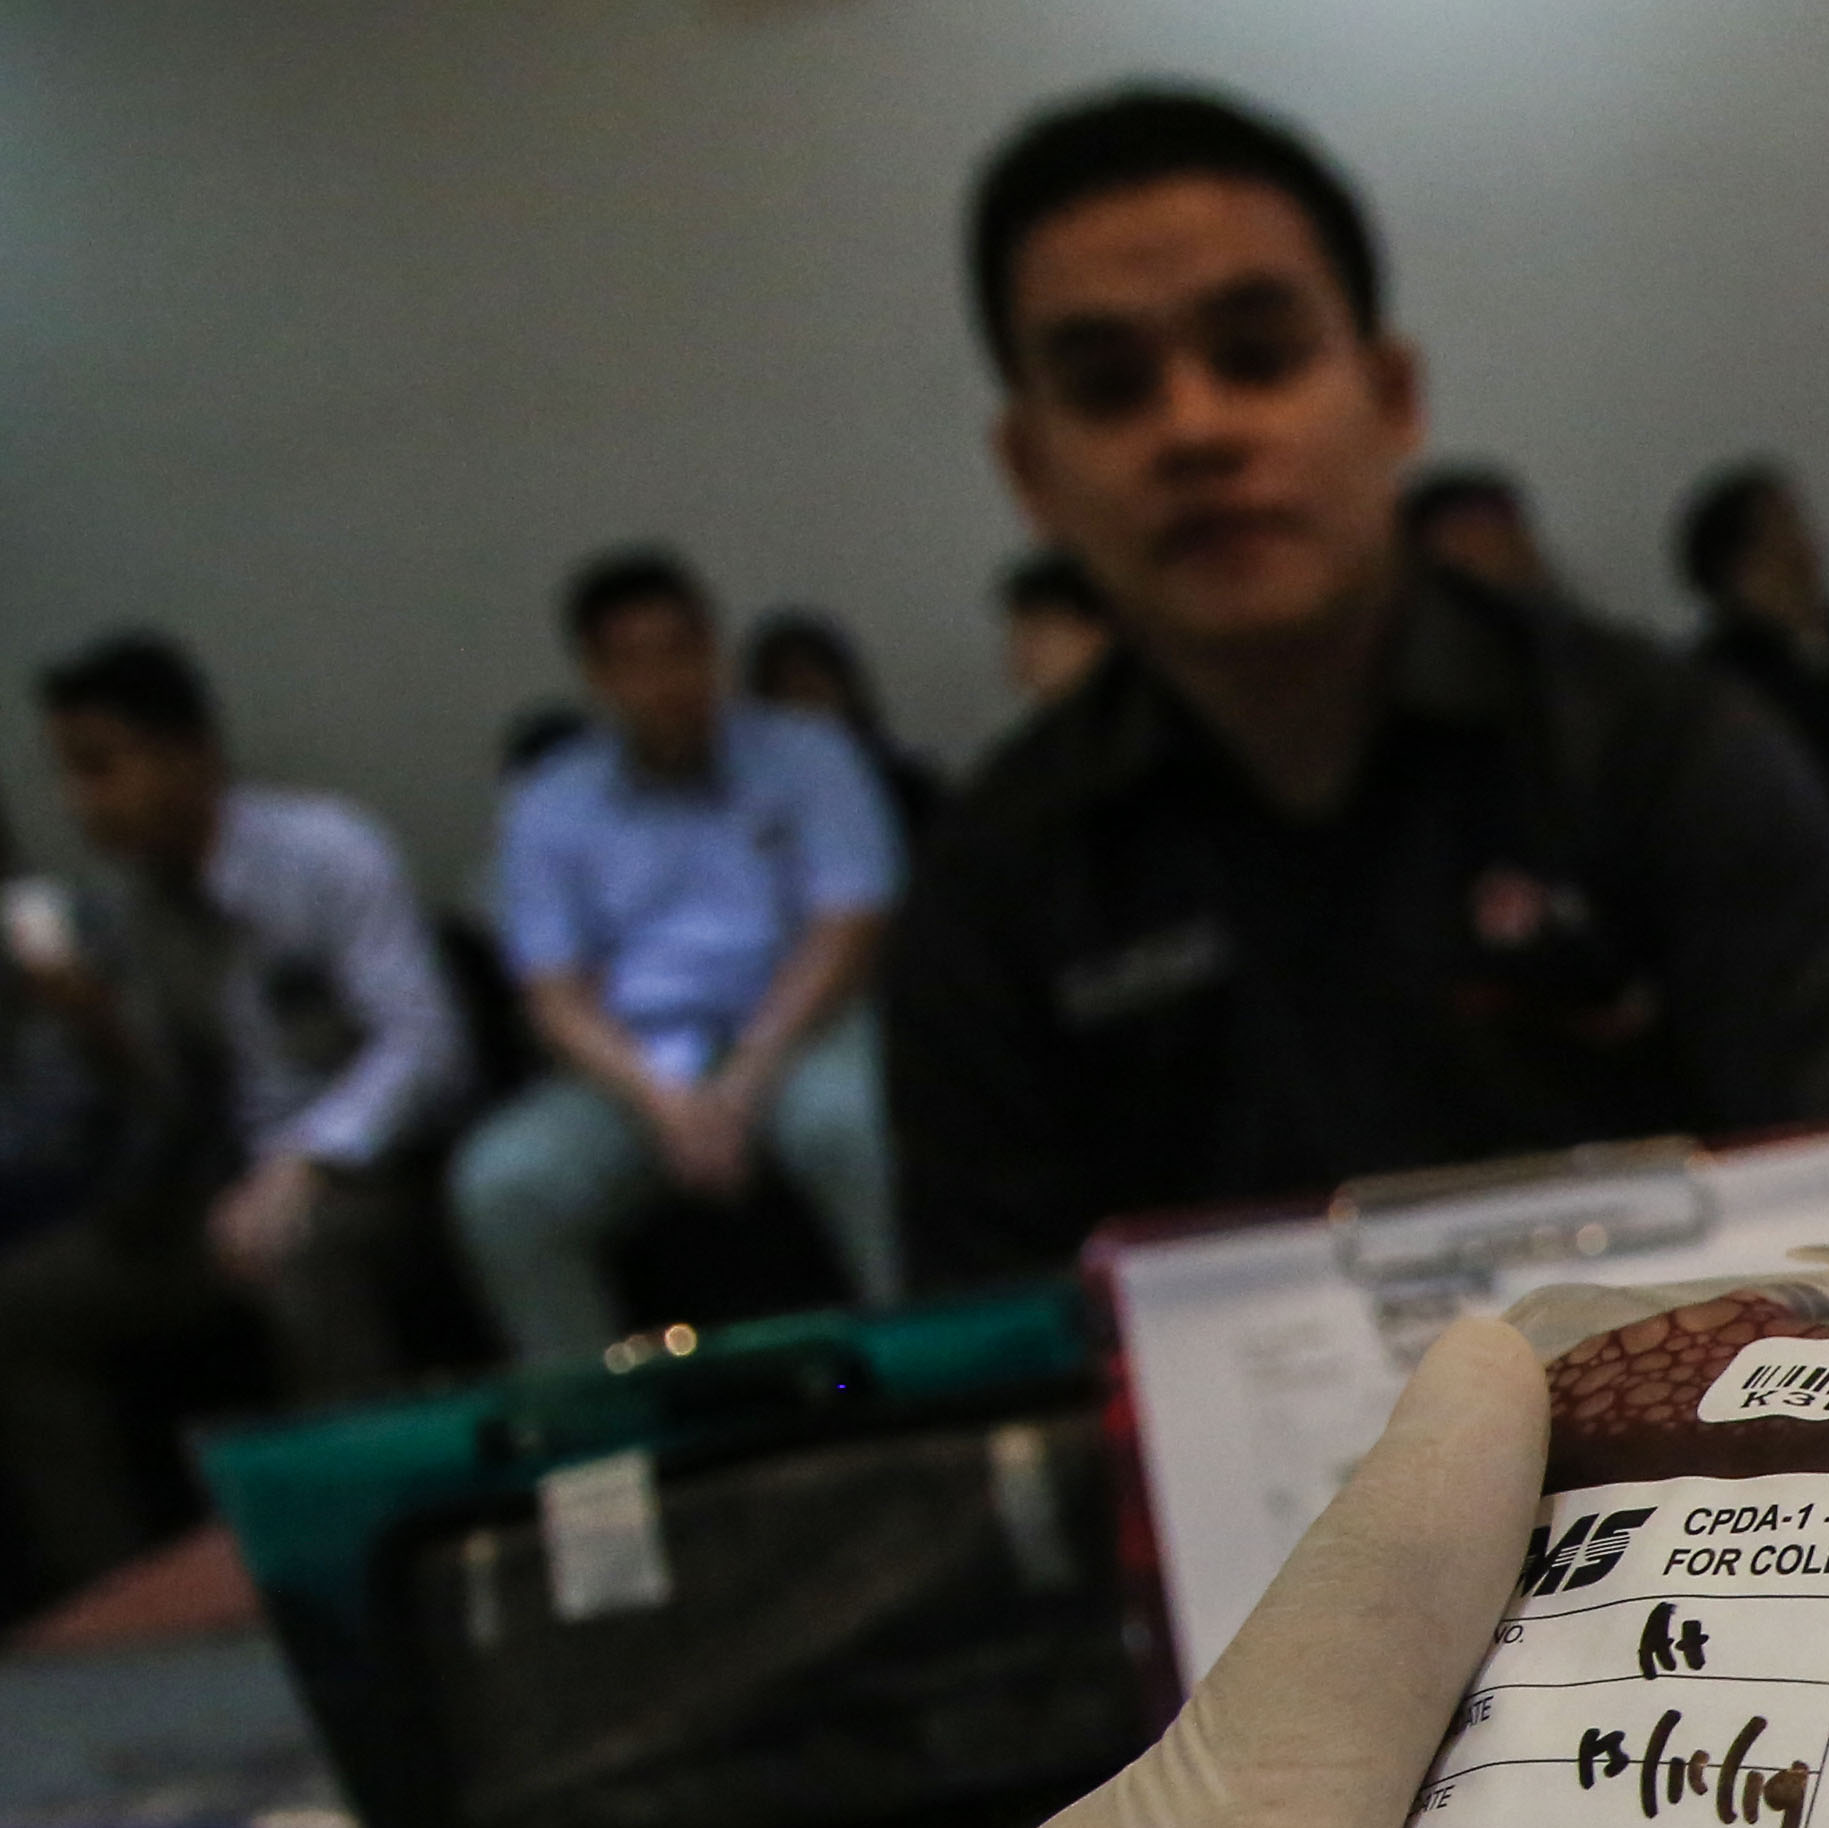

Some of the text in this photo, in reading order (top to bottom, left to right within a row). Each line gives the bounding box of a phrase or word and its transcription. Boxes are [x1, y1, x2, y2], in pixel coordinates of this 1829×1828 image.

[1683, 1503, 1814, 1537] CPDA-1
[1662, 1547, 1738, 1578] FOR
[1418, 1785, 1454, 1813] ATE
